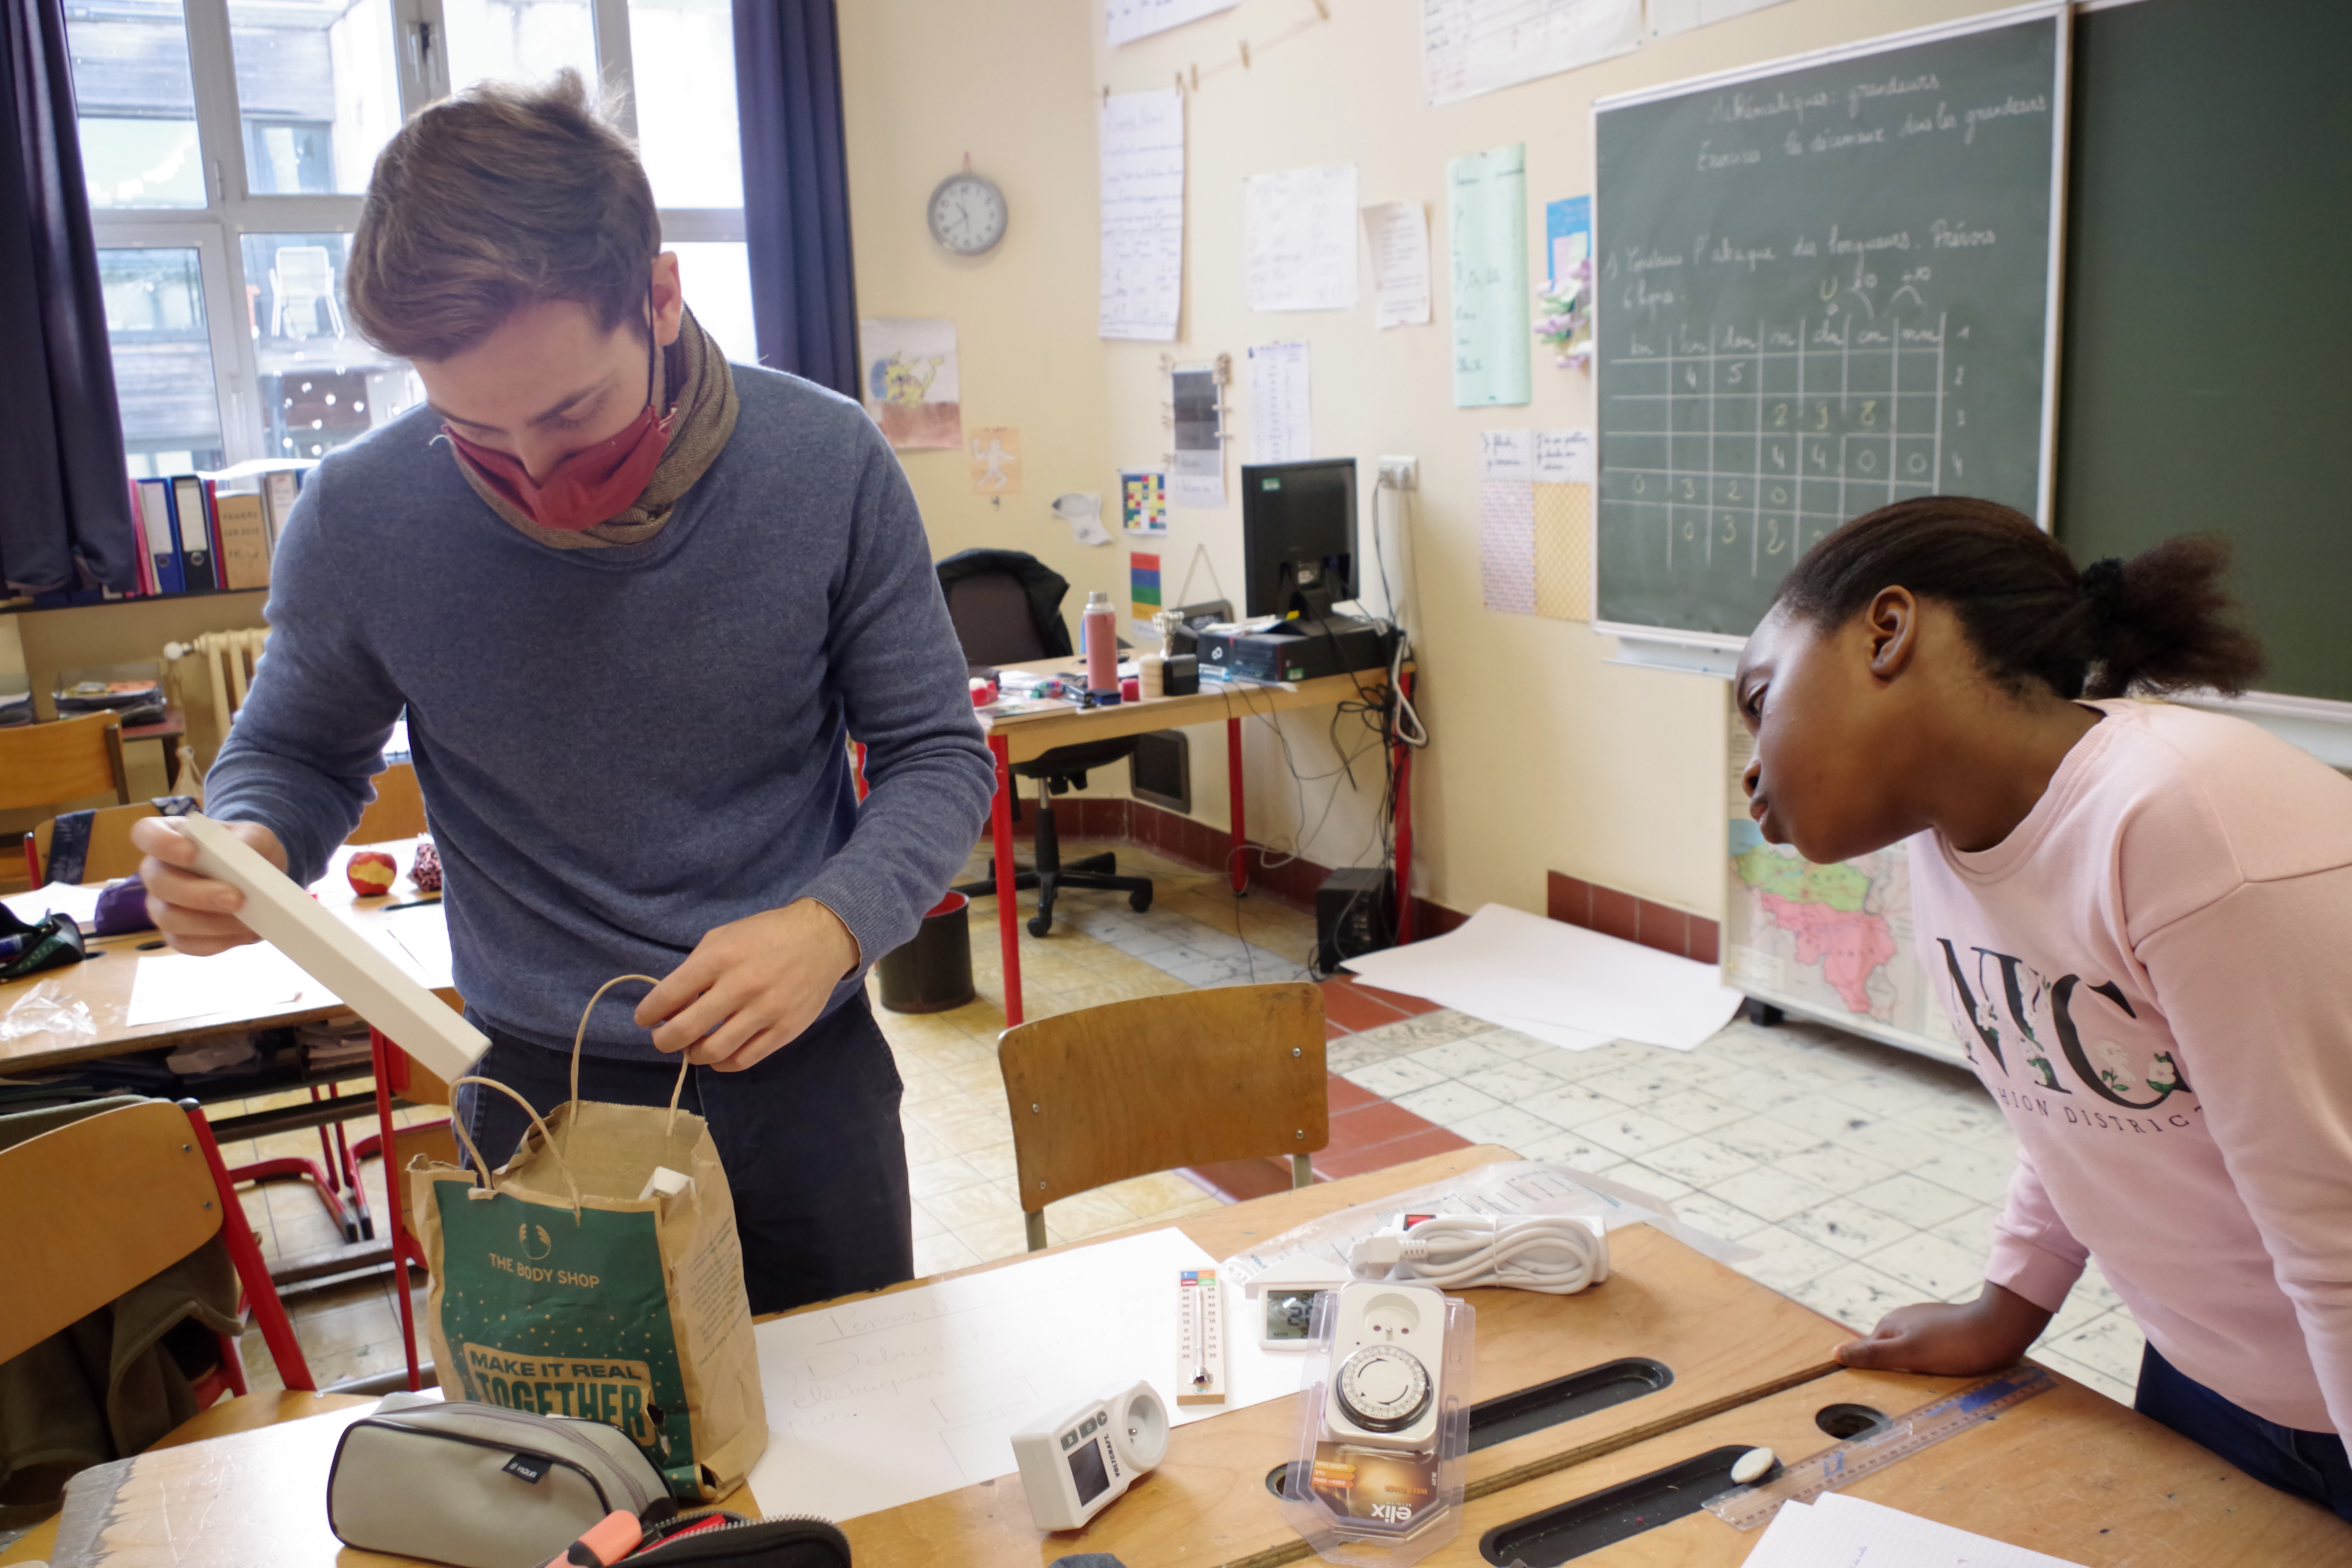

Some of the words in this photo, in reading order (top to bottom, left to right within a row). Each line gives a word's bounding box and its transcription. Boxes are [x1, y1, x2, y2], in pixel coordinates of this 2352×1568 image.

[1685, 364, 1697, 388] 4
[1728, 362, 1745, 384] 5
[1771, 444, 1786, 470] 4
[1811, 443, 1827, 471] 4
[1856, 448, 1877, 473] 0
[1906, 452, 1926, 473] 0
[1680, 477, 1696, 500] 3
[1770, 486, 1788, 506] 0
[1722, 514, 1737, 544] 3
[489, 1253, 514, 1273] THE
[517, 1262, 554, 1282] BODY
[557, 1270, 600, 1289] SHOP
[470, 1351, 535, 1376] MAKE
[541, 1363, 564, 1377] IT
[571, 1364, 642, 1380] REAL
[1371, 1503, 1412, 1524] elix
